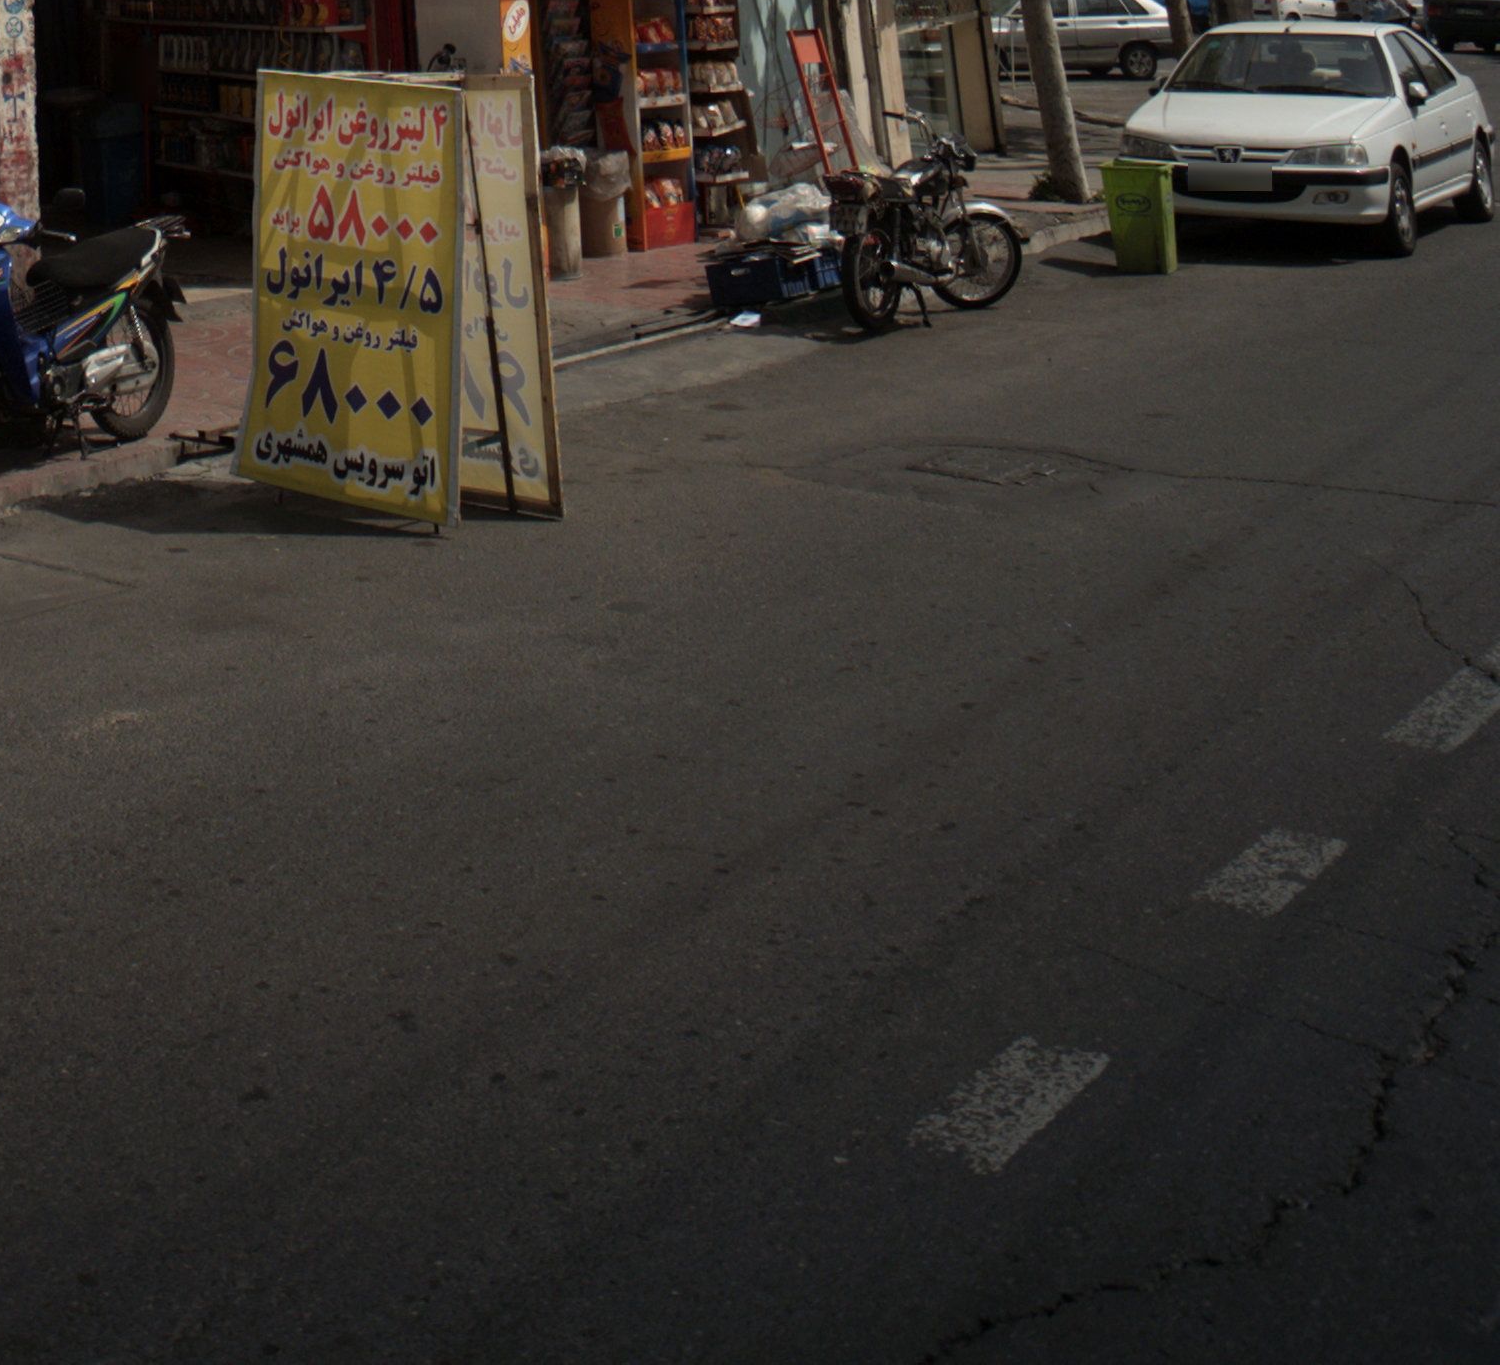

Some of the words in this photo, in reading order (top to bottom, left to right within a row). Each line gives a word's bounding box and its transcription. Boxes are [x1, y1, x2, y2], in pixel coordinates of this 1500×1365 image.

[267, 91, 334, 143] ایرانول
[337, 101, 391, 151] روغن
[390, 105, 427, 152] لیتر
[432, 104, 449, 148] ۴
[273, 149, 331, 175] هواکش
[334, 162, 345, 179] و
[349, 159, 396, 185] روغن
[401, 164, 442, 188] فیلتر
[271, 209, 301, 235] براید
[307, 183, 438, 247] ۵۸۰۰۰
[265, 246, 364, 307] ایرانول
[281, 310, 329, 339] هواکش
[331, 324, 340, 341] و
[343, 322, 381, 348] روغن
[385, 328, 419, 353] فیلتر
[264, 339, 434, 427] ۶۸۰۰۰
[255, 428, 329, 465] همشهری
